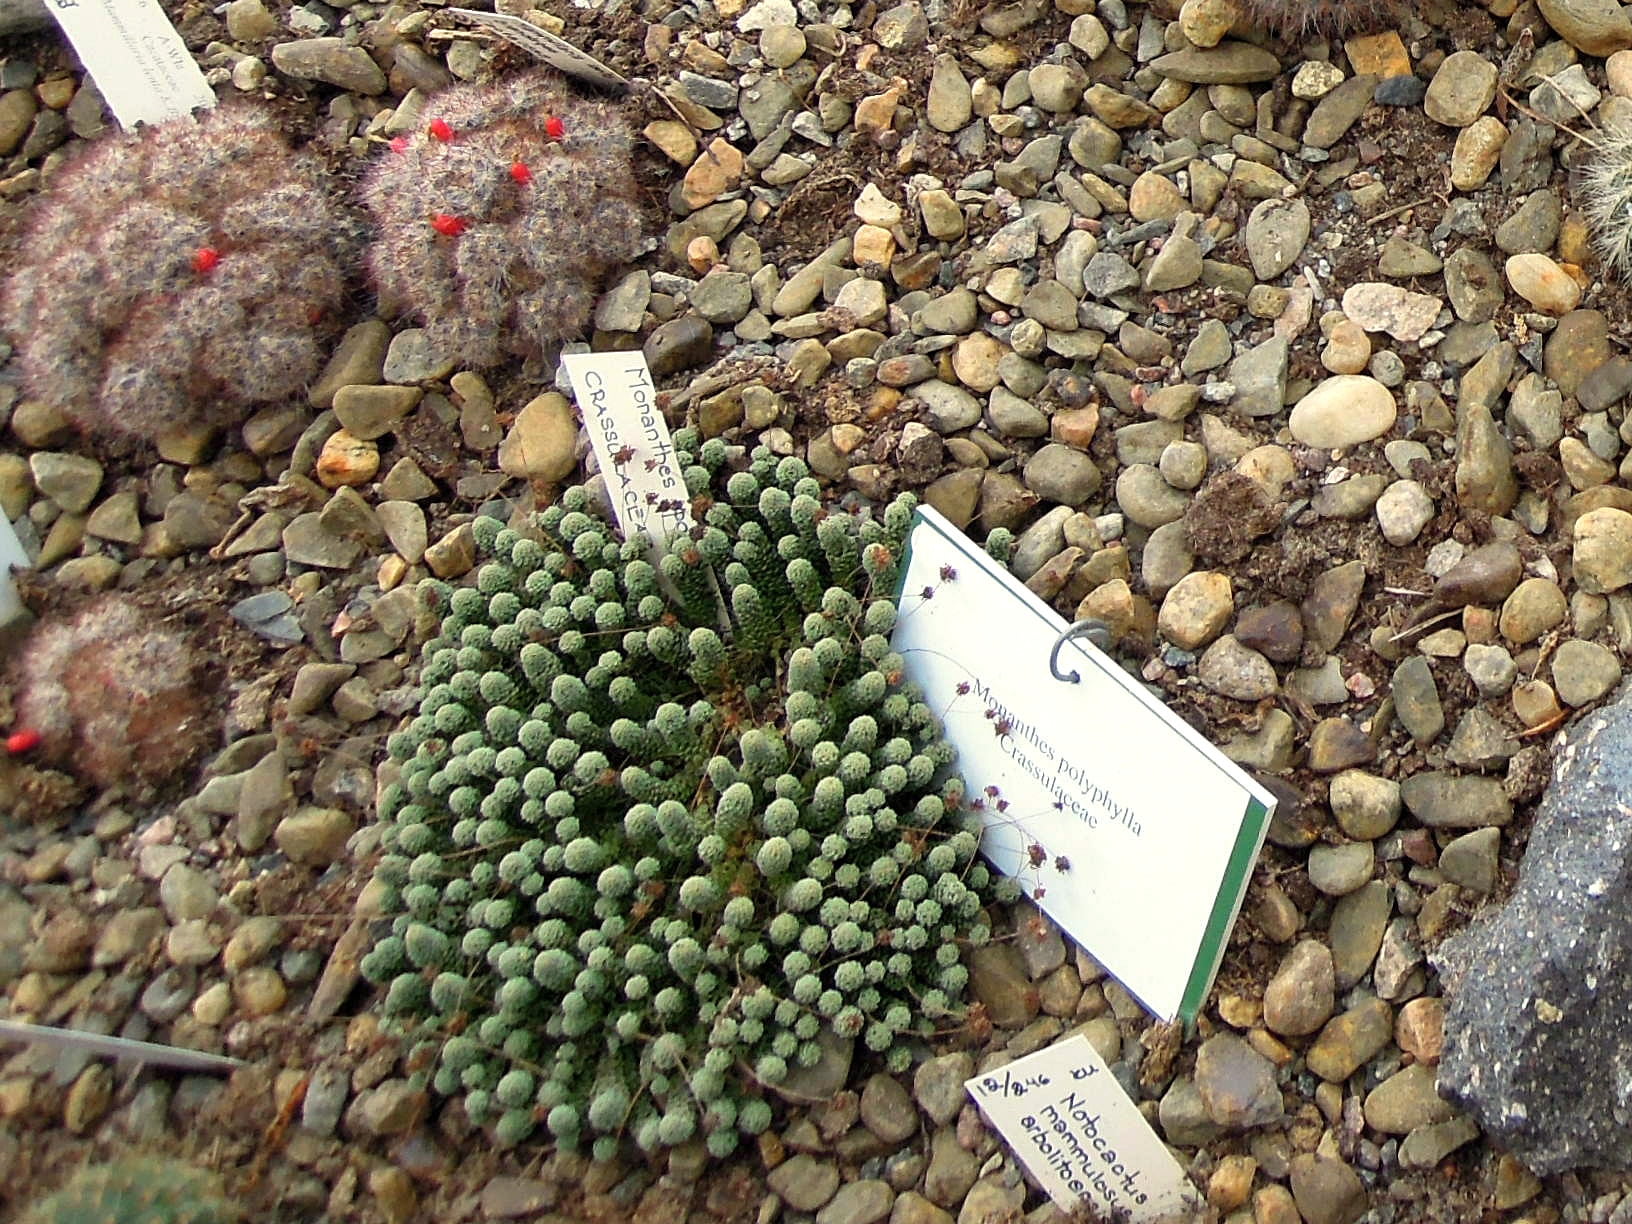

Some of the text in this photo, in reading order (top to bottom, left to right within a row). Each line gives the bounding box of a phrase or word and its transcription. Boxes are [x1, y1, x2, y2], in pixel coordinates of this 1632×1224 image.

[625, 368, 676, 489] Monanthes
[971, 678, 1144, 837] Monanthes polyphylla
[1000, 732, 1099, 830] Crassulaceae
[1059, 1092, 1148, 1205] Notocactus
